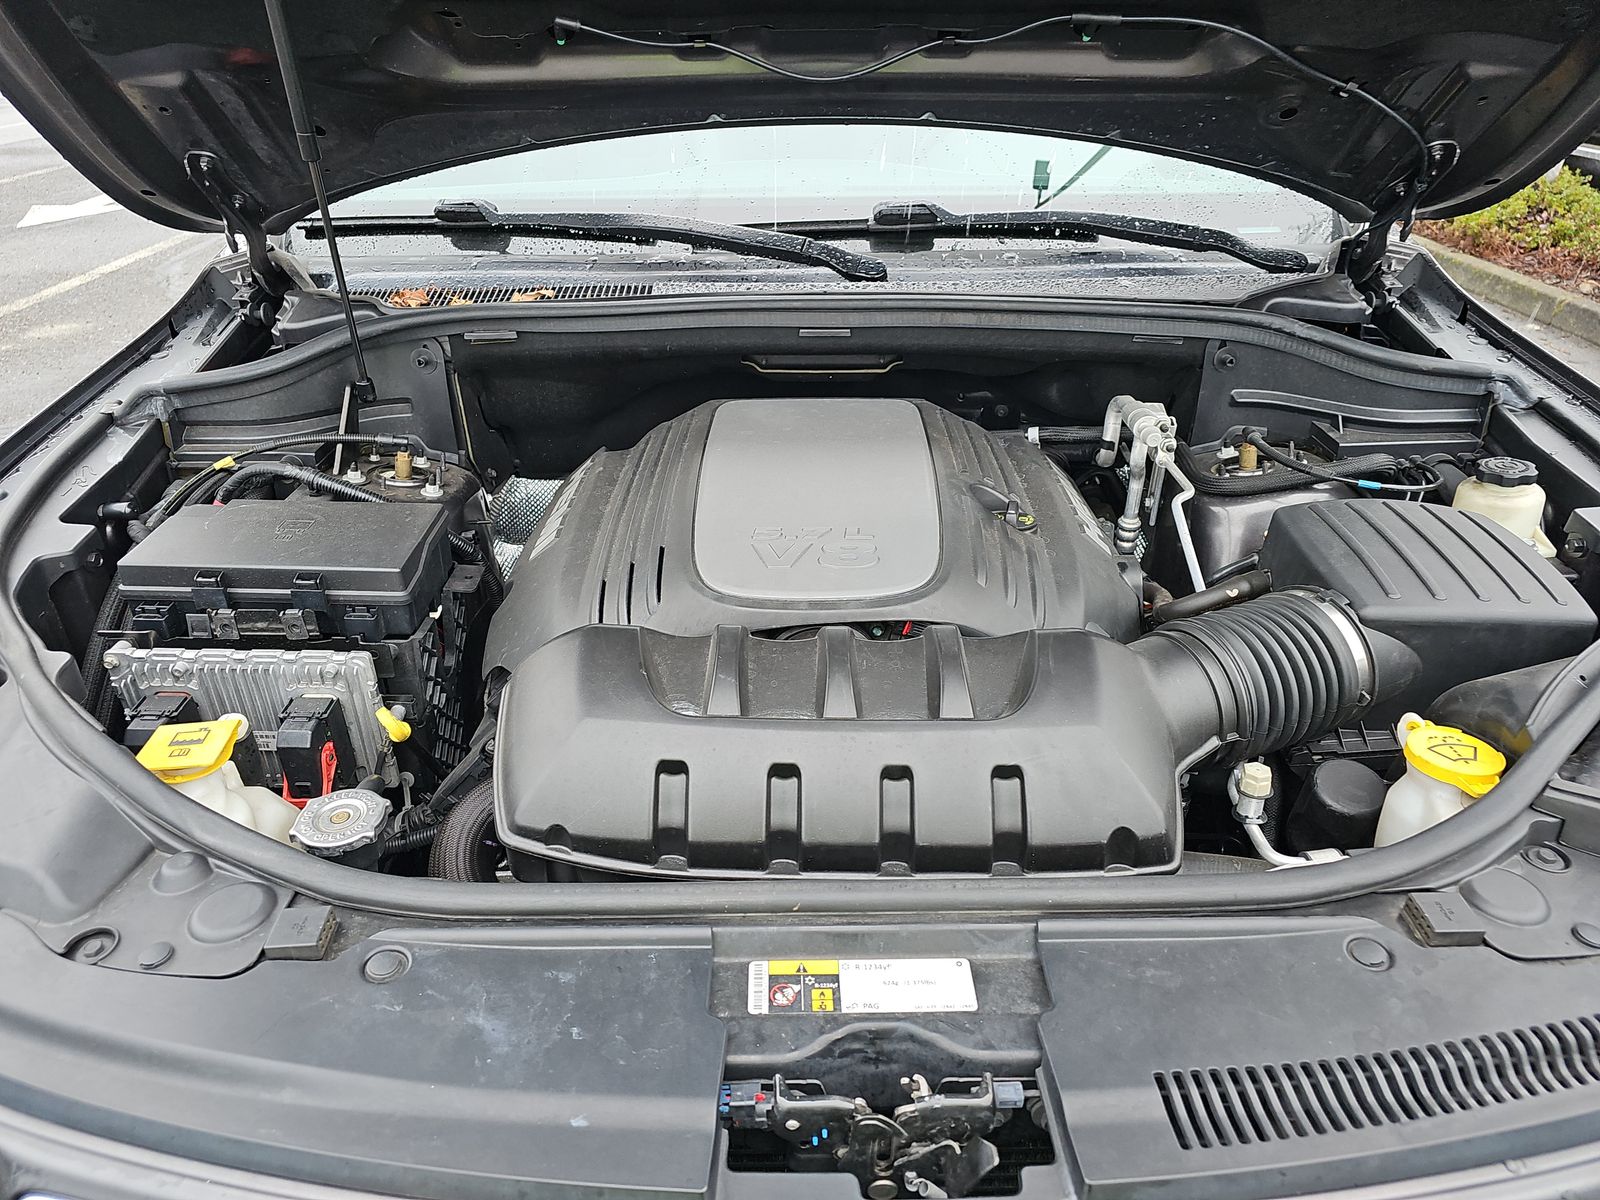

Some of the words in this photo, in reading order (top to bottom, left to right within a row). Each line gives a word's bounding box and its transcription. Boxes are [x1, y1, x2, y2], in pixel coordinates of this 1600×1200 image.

[751, 526, 875, 541] 5.7L
[751, 543, 881, 568] V8
[313, 832, 346, 841] OPEN
[347, 819, 369, 836] HOT
[863, 1002, 880, 1010] PAG
